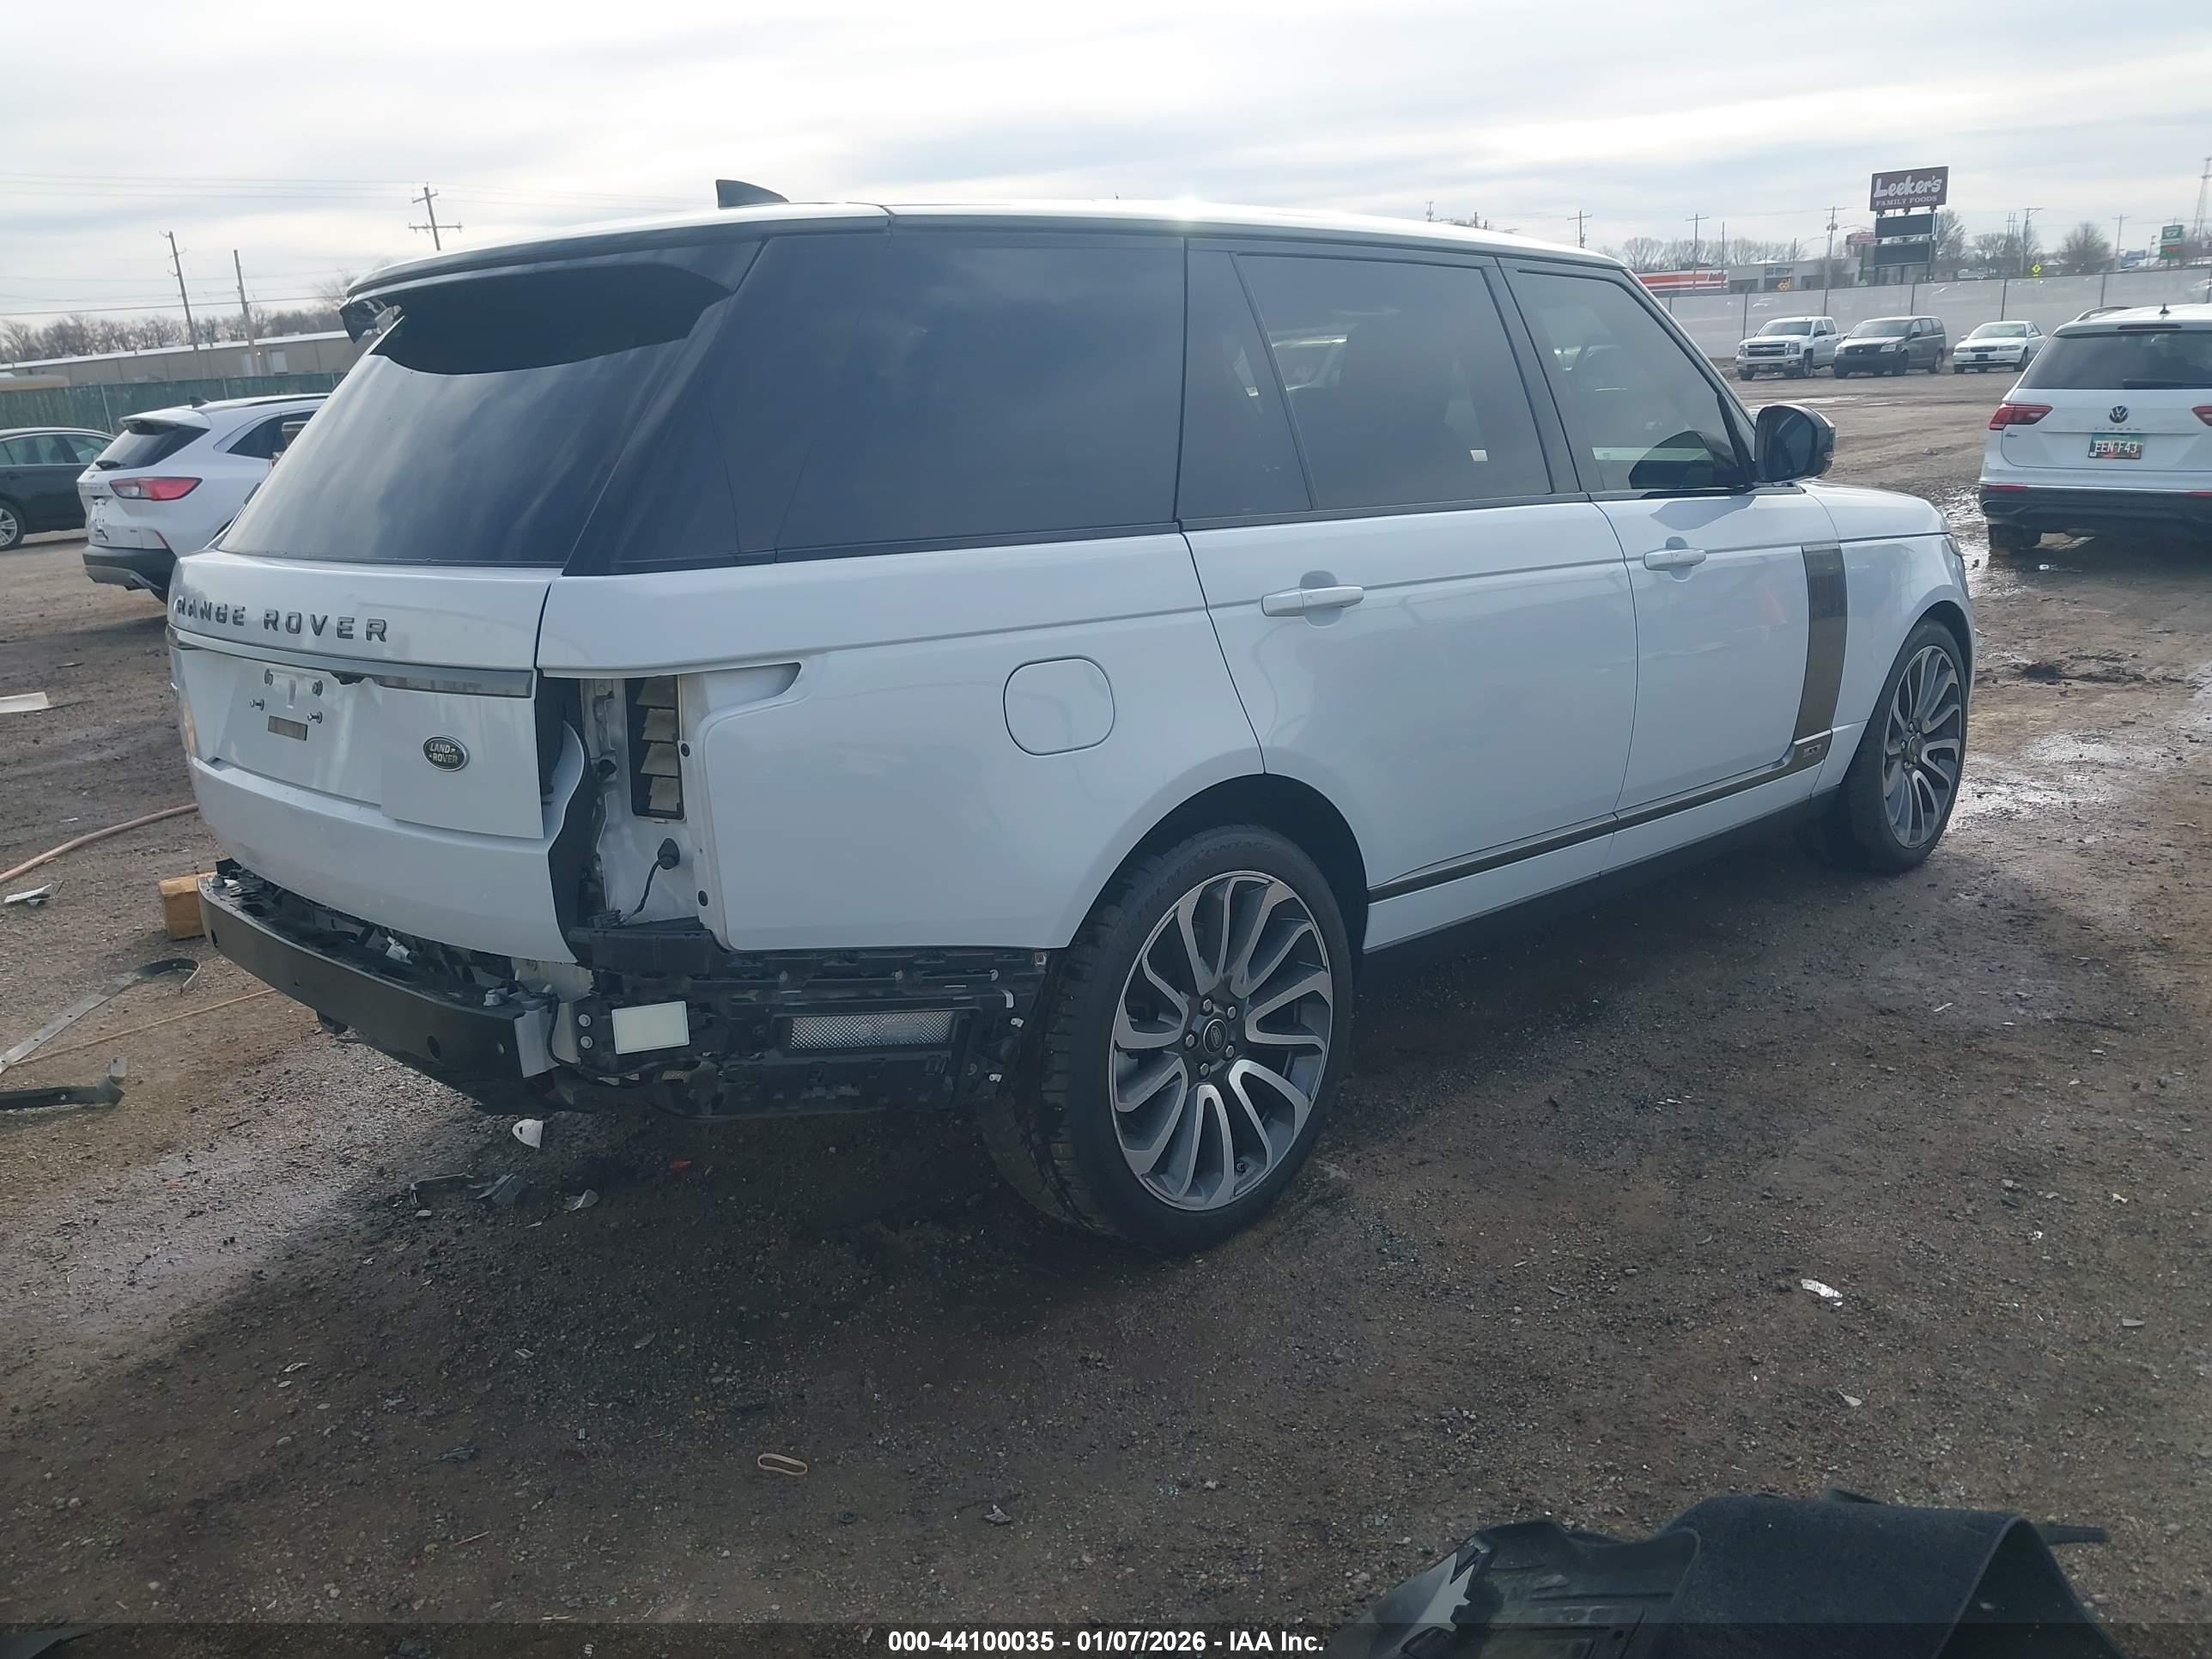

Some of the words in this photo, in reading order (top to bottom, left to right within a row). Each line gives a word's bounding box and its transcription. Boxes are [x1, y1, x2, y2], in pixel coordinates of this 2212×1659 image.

[1873, 174, 1942, 198] Leeker's
[1875, 198, 1907, 207] FAMILY
[1909, 195, 1938, 204] FOODS
[175, 596, 247, 627] RANGE
[263, 608, 386, 643] ROVER
[429, 742, 451, 754] LAND
[432, 752, 459, 764] ROVER
